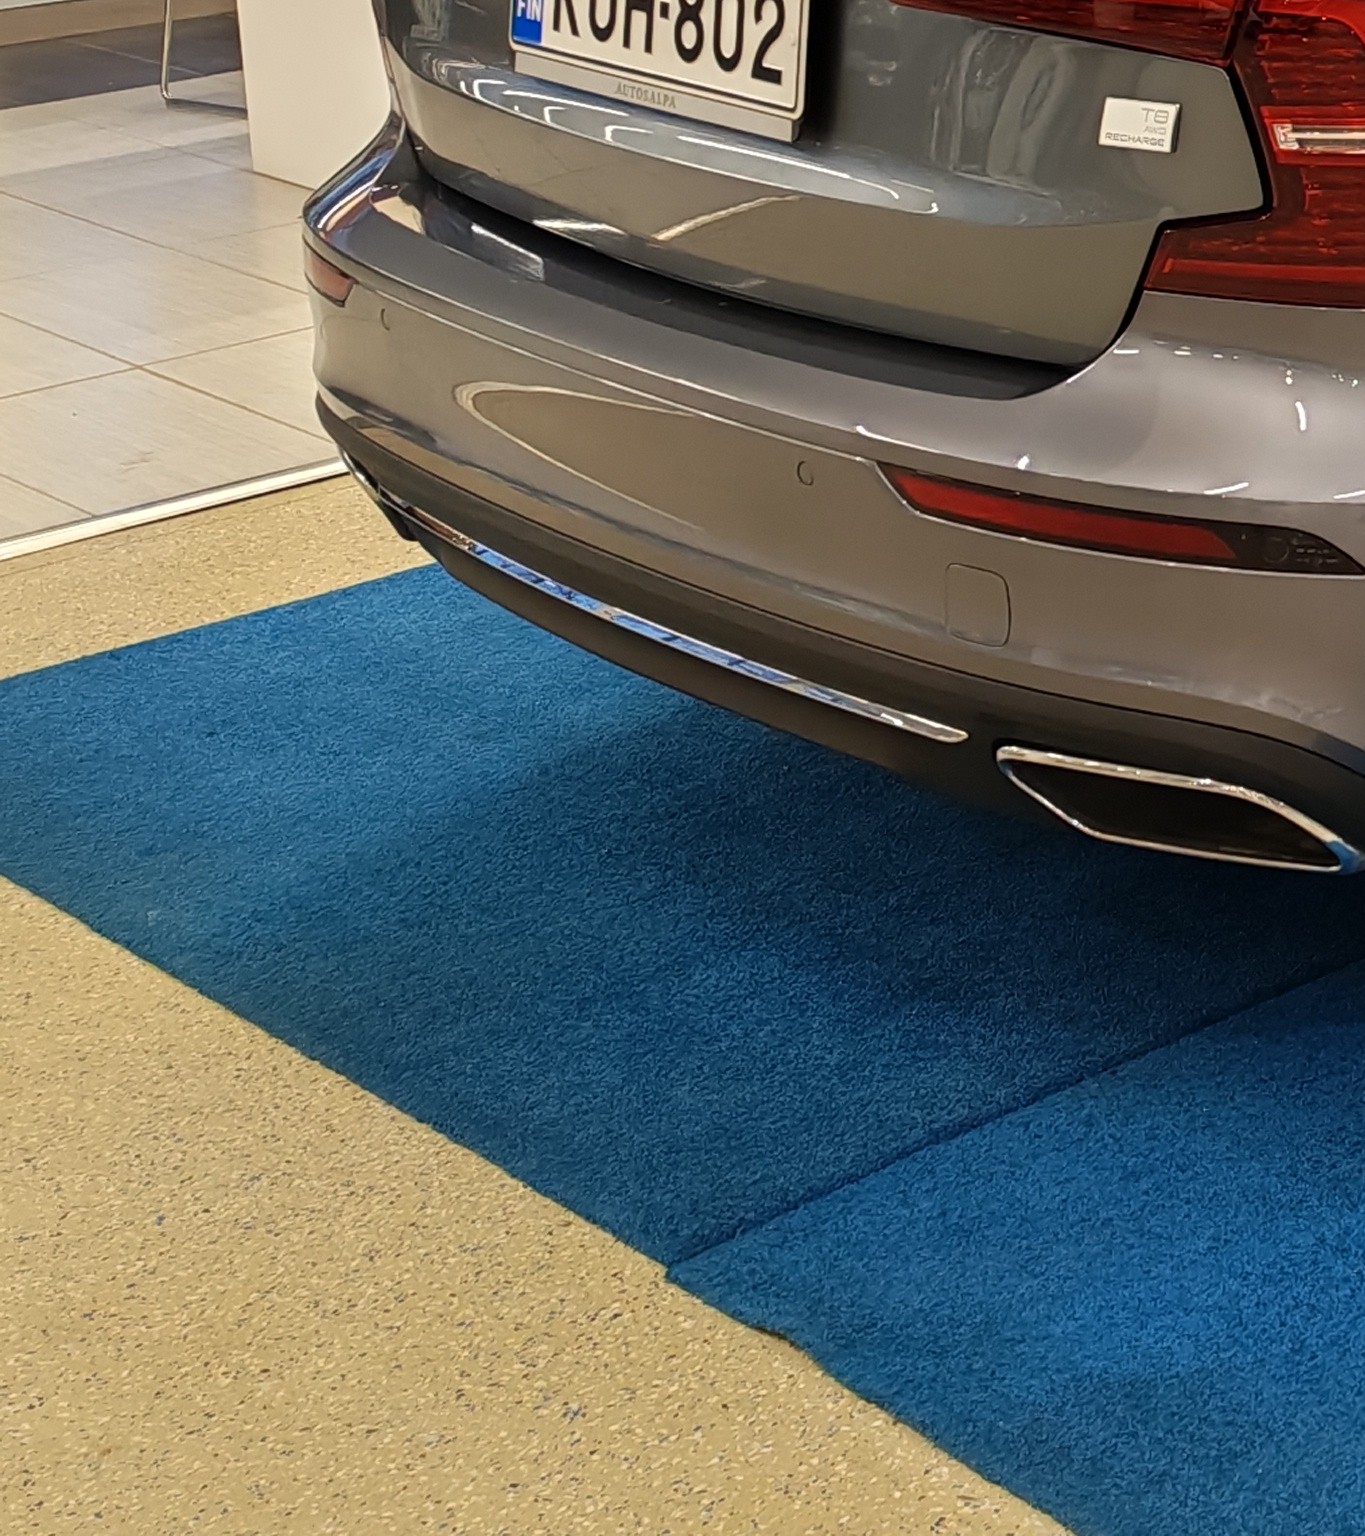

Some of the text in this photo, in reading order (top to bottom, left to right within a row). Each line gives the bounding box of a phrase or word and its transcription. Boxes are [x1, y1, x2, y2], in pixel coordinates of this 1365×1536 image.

[614, 81, 677, 110] AUTOSALPA
[1141, 107, 1170, 124] T8
[1105, 132, 1164, 146] RECHARGE
